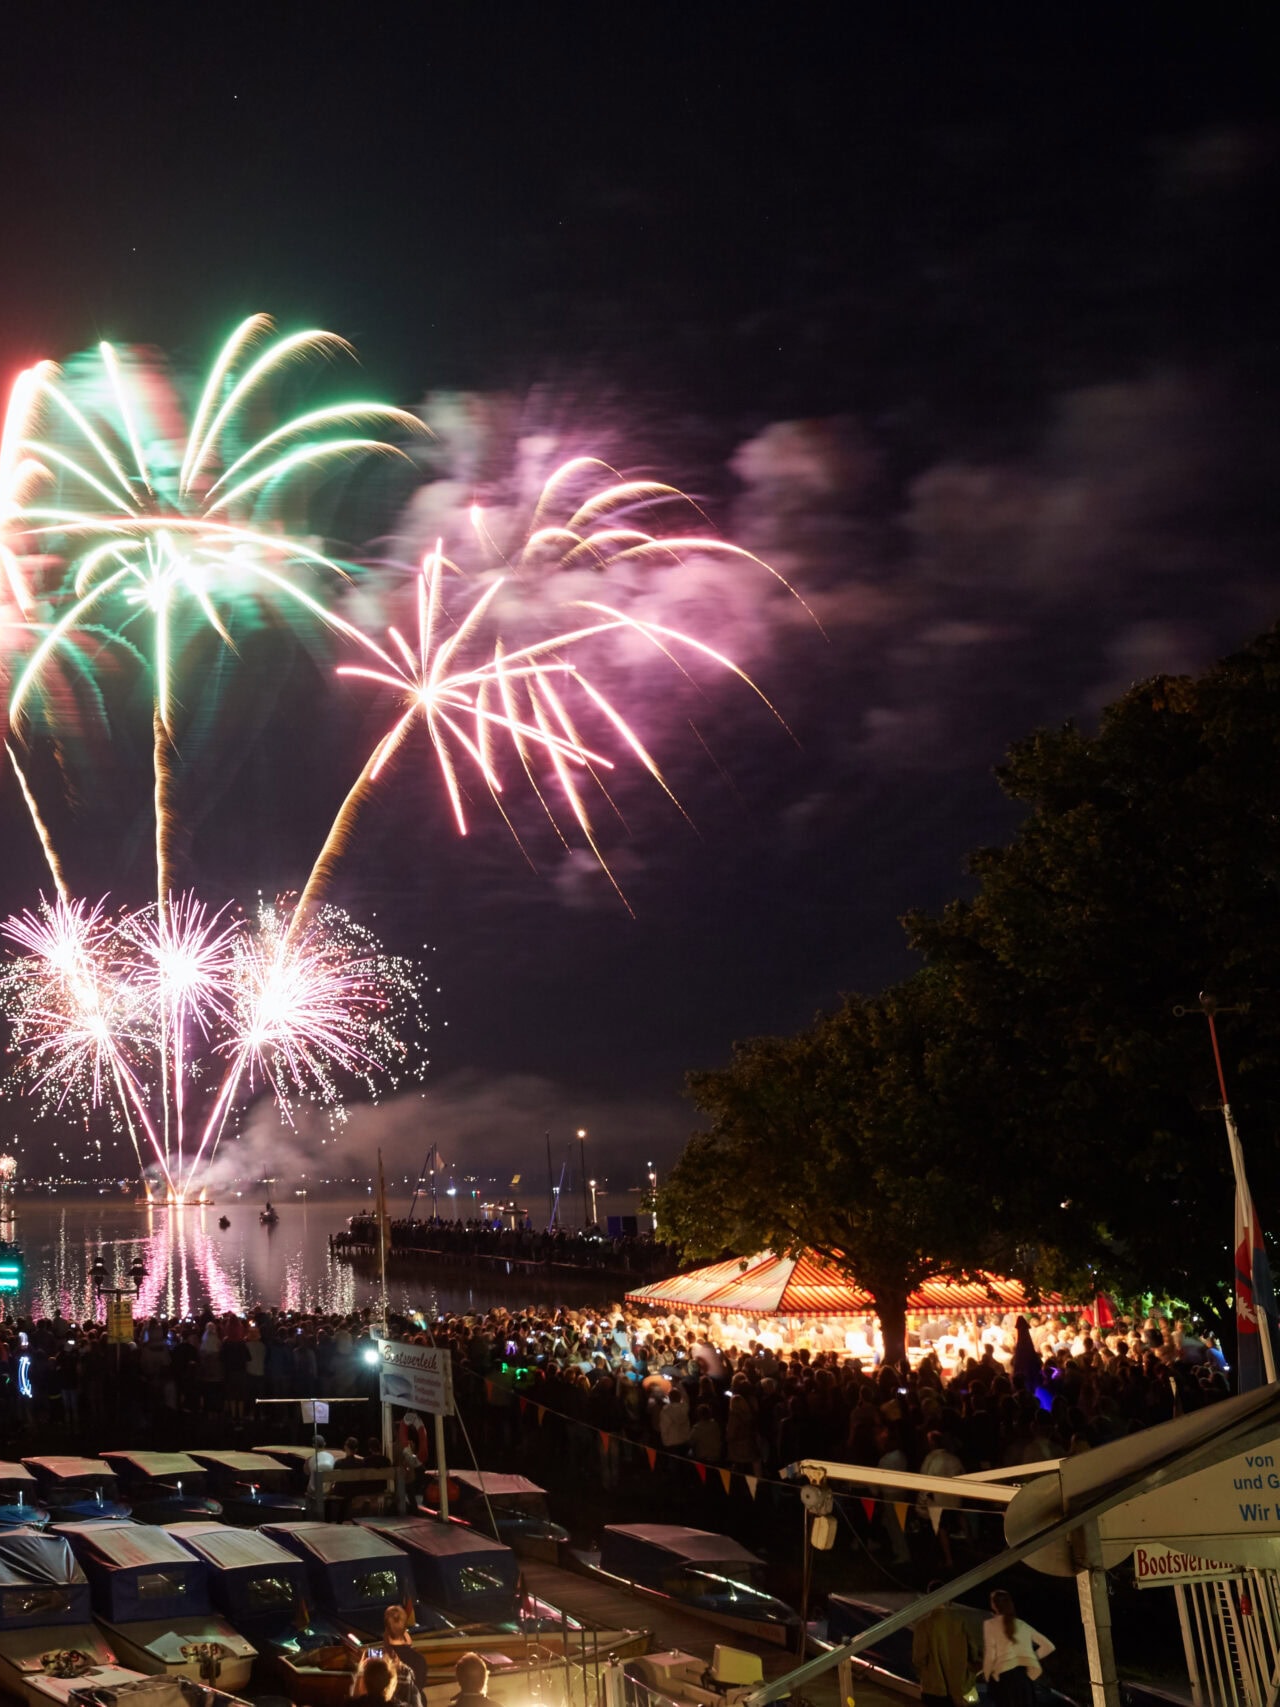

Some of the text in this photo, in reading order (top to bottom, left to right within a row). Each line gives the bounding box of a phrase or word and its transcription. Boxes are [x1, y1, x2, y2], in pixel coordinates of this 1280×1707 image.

[1245, 1456, 1274, 1468] von
[1233, 1474, 1263, 1490] und
[1239, 1503, 1270, 1521] Wir
